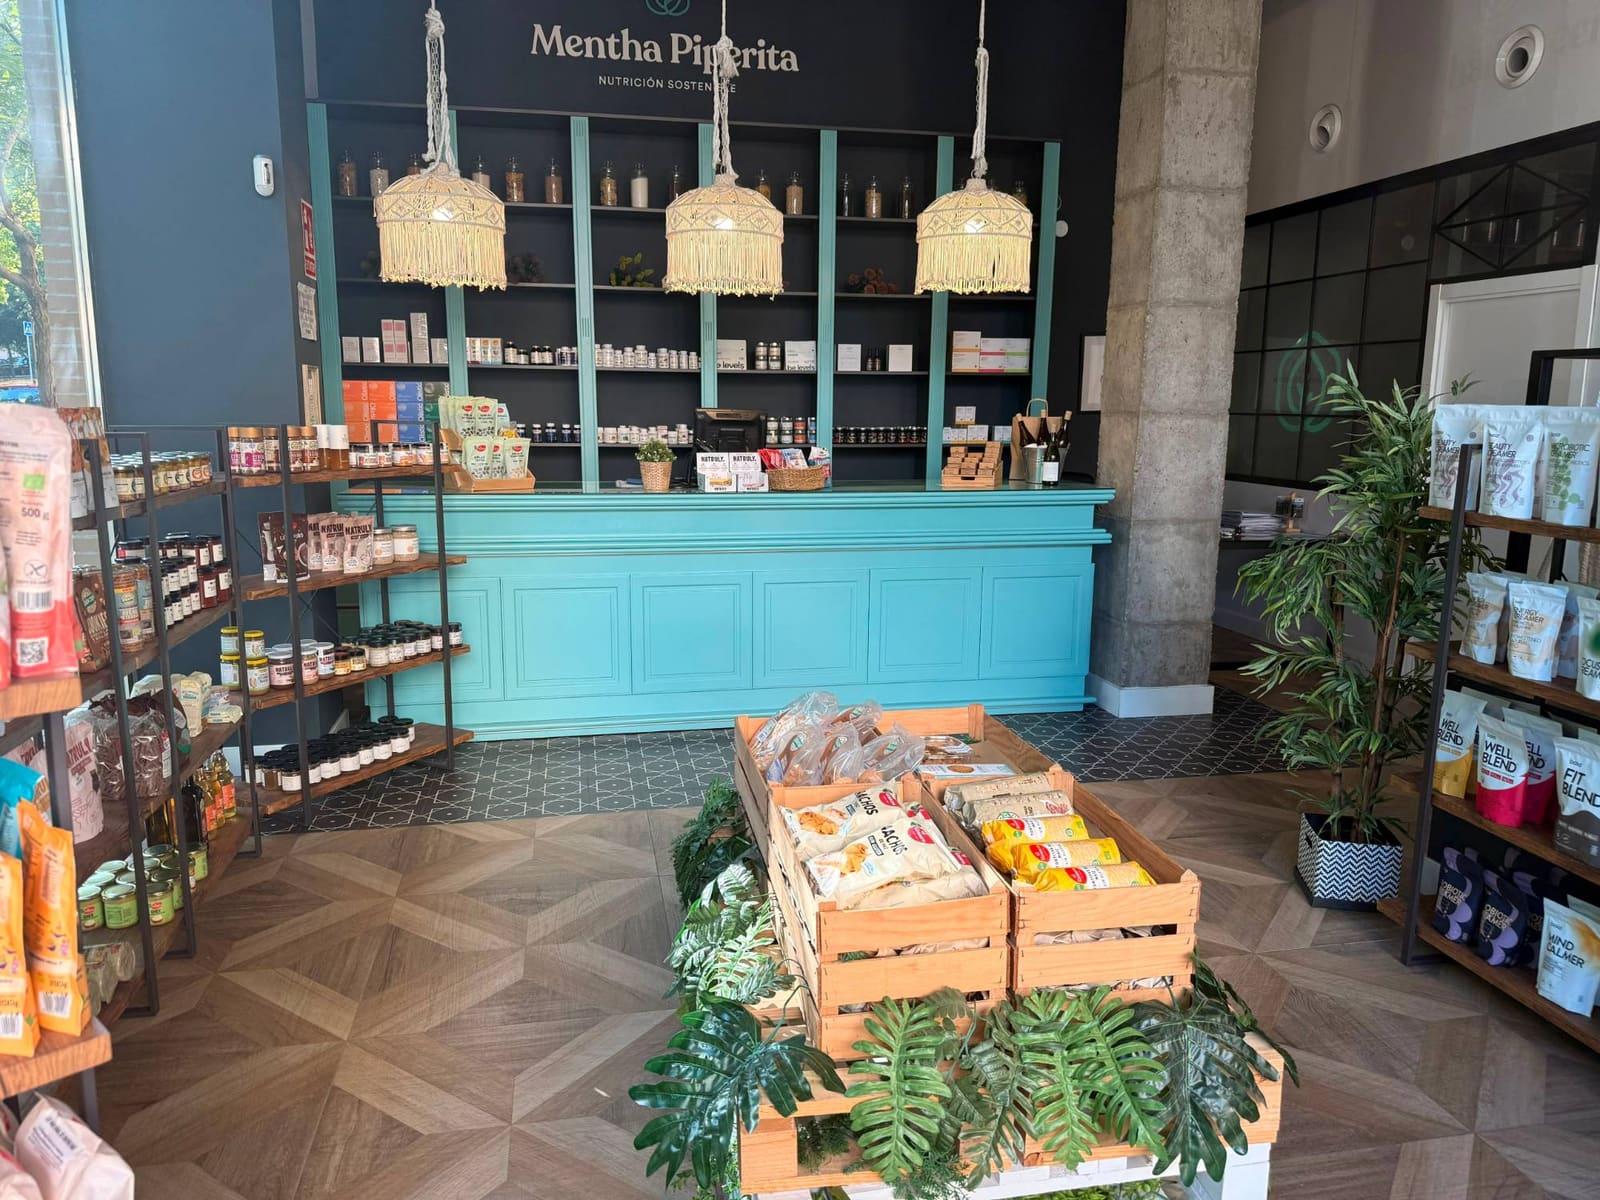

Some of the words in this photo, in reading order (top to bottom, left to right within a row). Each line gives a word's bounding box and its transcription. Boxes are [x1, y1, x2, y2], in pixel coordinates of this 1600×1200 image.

[530, 23, 662, 63] Mentha
[670, 33, 800, 75] Piperita
[598, 75, 664, 89] NUTRICIÓN
[667, 80, 737, 93] SOSTENE
[21, 507, 41, 518] 500
[1441, 718, 1460, 734] WELL
[1436, 728, 1464, 746] BLEND
[1484, 740, 1513, 760] WELL
[1525, 740, 1542, 757] ELL
[1482, 751, 1517, 773] BLEND
[1563, 767, 1586, 785] FIT
[1562, 781, 1600, 808] BLEND
[1546, 942, 1585, 969] CALMER
